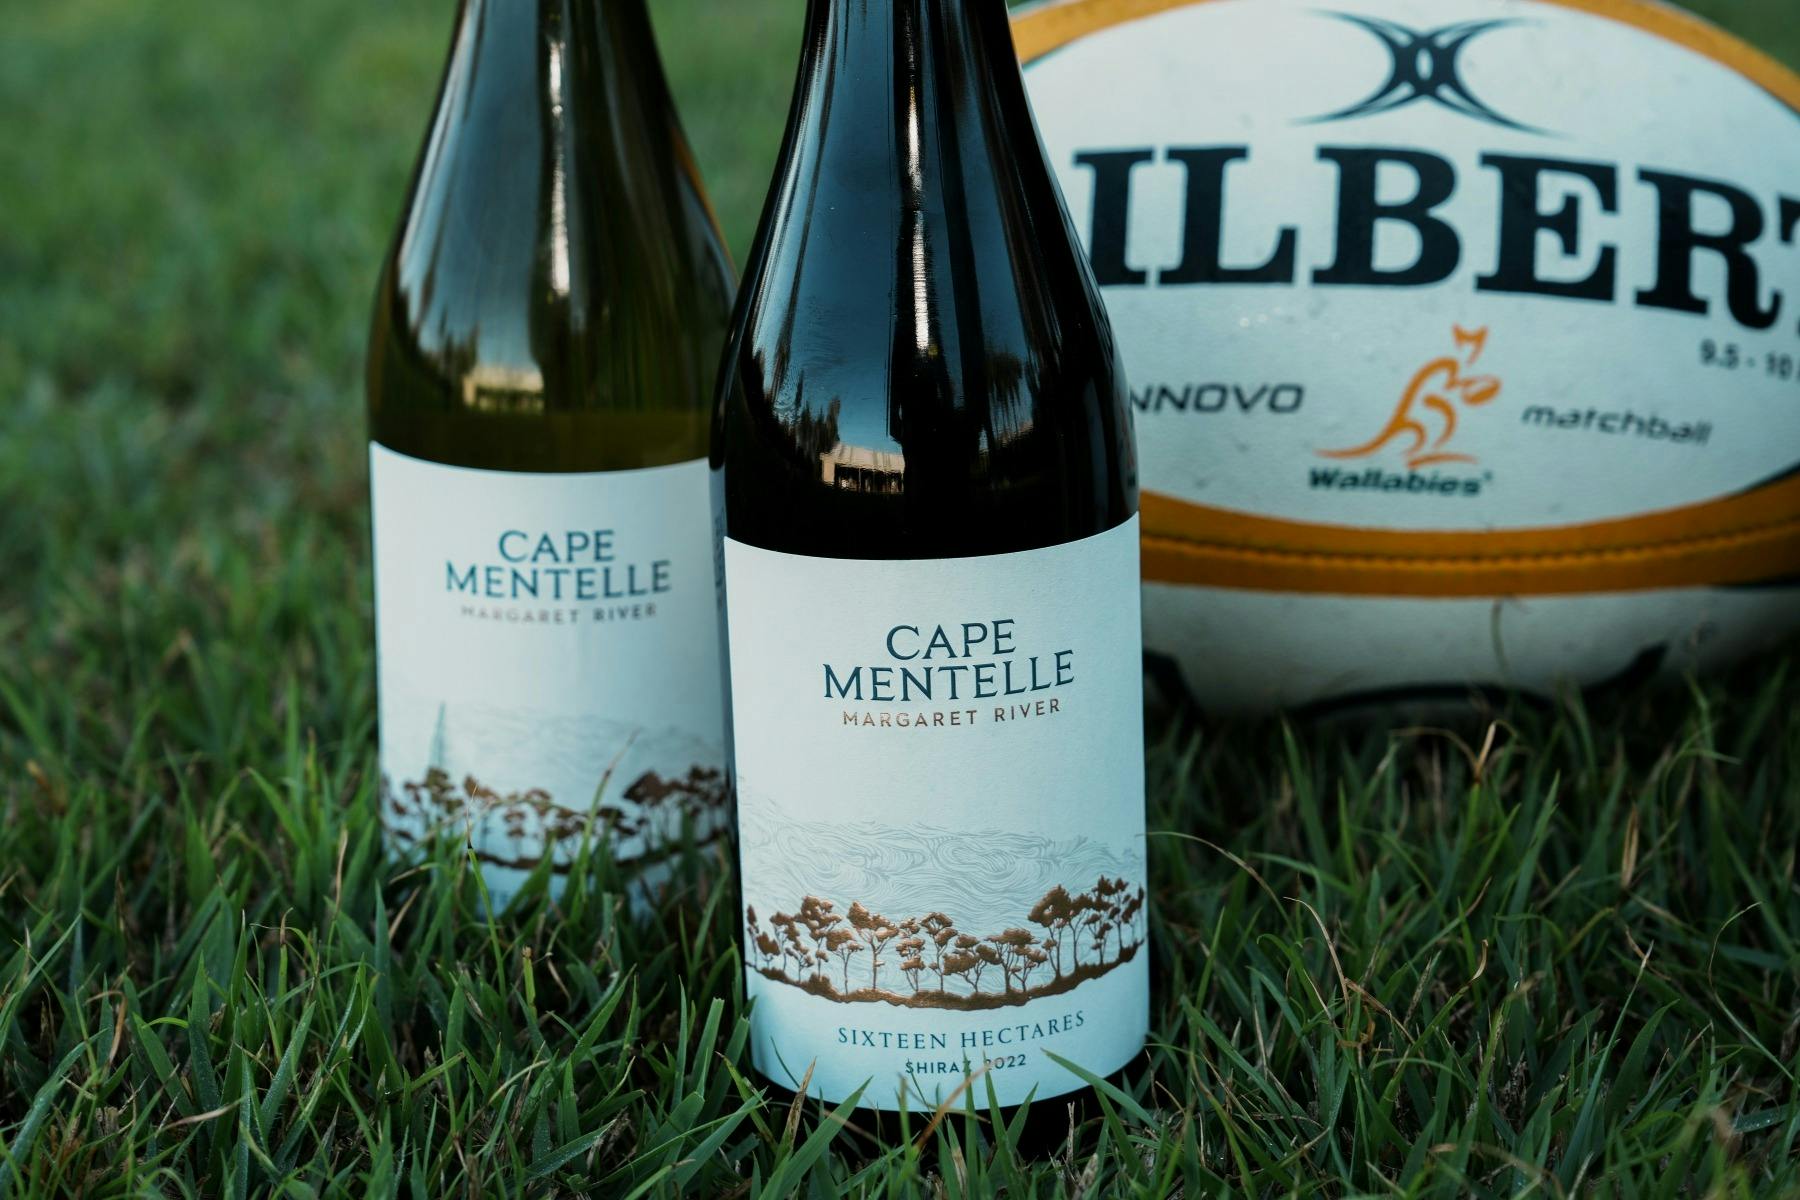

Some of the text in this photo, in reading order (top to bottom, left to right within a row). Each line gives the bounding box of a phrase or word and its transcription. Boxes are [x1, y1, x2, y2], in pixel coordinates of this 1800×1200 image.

[1073, 145, 1800, 336] ILBER
[1130, 384, 1304, 414] NNOVO
[1522, 404, 1713, 447] matchball
[1308, 467, 1482, 496] Wallabies
[498, 529, 615, 563] CAPE
[446, 560, 671, 600] MENTELLE
[461, 602, 657, 625] MARGARET RIVER
[886, 618, 1017, 660] CAPE
[822, 649, 1075, 702] MENTELLE
[843, 697, 1061, 728] MARGARET RIVER
[838, 1010, 1085, 1049] SIXTEEN HECTARES
